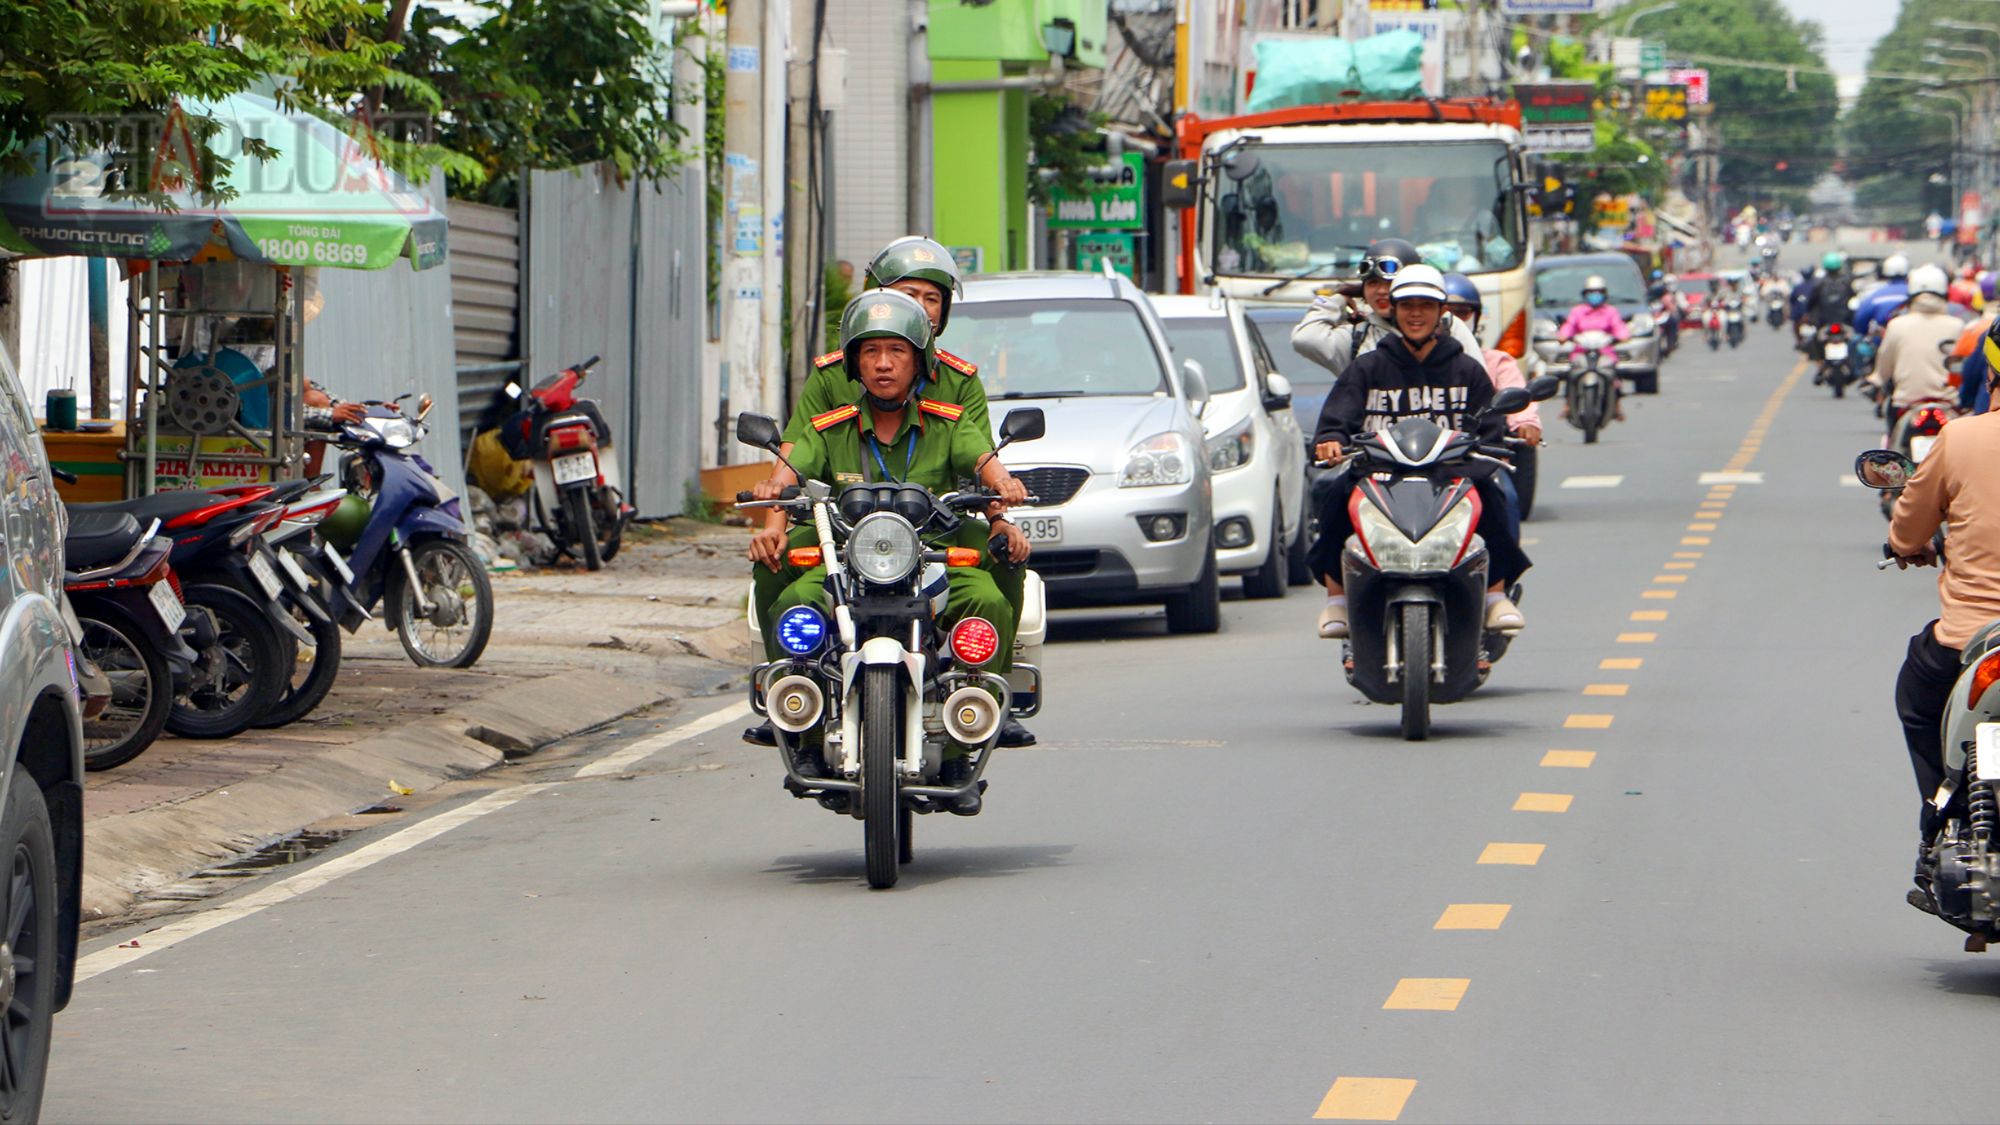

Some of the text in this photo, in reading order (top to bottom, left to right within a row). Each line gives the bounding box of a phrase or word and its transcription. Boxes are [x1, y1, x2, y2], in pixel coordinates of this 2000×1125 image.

[258, 239, 367, 264] 1800 6869
[1366, 389, 1402, 412] HEY
[1408, 385, 1445, 411] BAE
